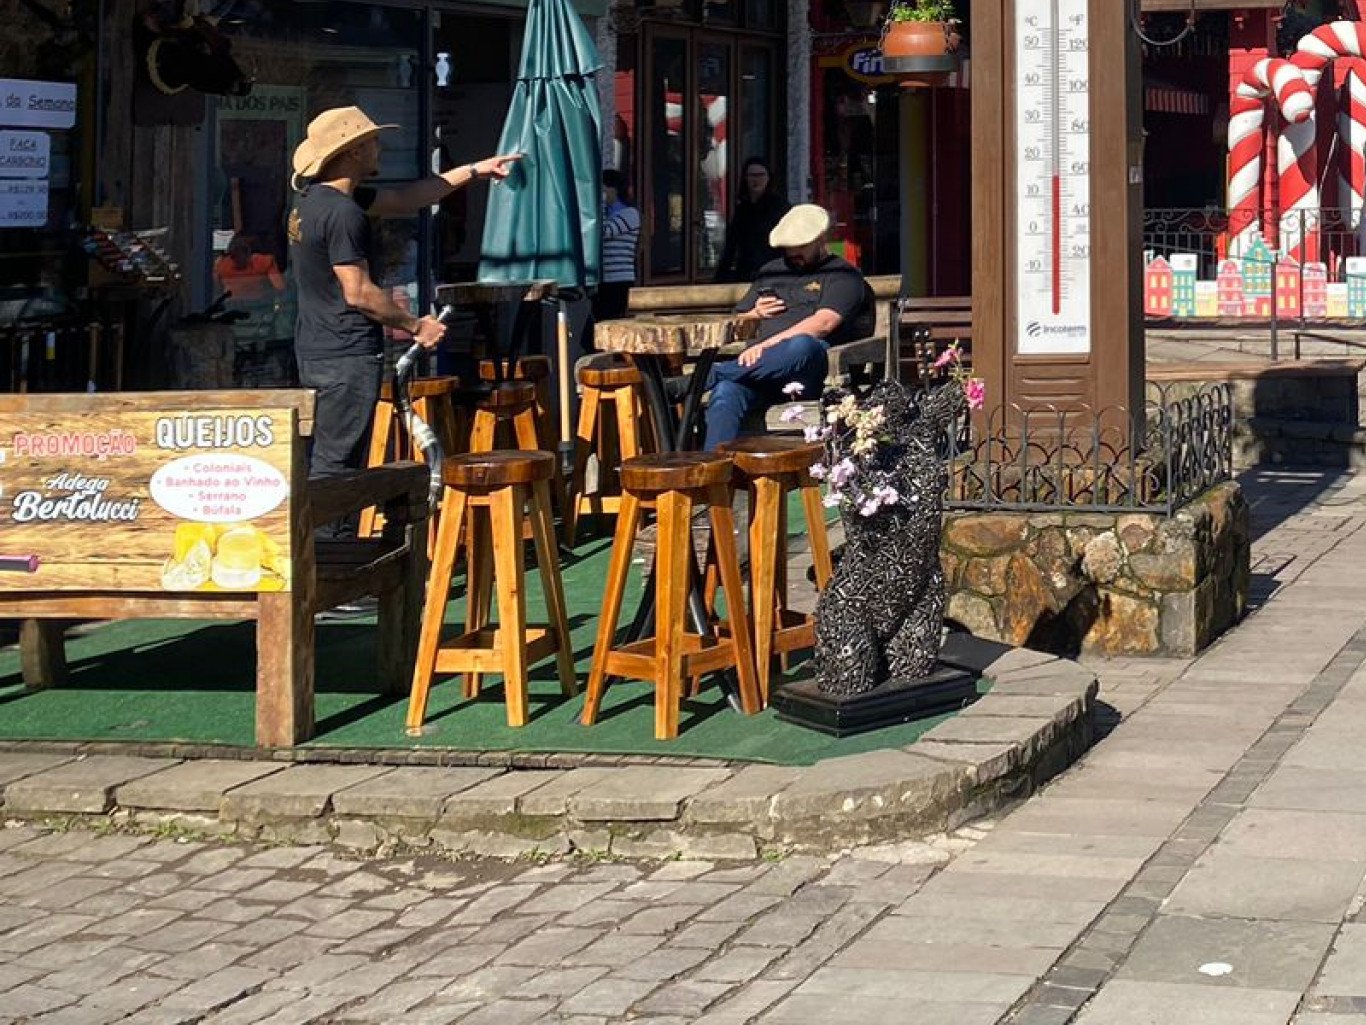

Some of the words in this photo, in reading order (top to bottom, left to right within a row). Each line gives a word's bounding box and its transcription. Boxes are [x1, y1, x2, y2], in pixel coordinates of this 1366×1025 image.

[1024, 36, 1039, 48] 50
[853, 51, 885, 73] Fin
[1024, 73, 1039, 85] 40
[1024, 110, 1040, 121] 30
[1024, 147, 1040, 159] 20
[1026, 184, 1039, 195] 10
[1029, 221, 1037, 233] 0
[156, 415, 273, 449] QUEIJOS
[13, 428, 137, 461] PROMOÇÃO
[45, 472, 109, 495] Adega
[165, 476, 220, 487] Banhado
[224, 478, 240, 487] ao
[243, 476, 281, 487] Vinho
[198, 490, 247, 501] Serrano
[12, 491, 140, 521] Bertolucci
